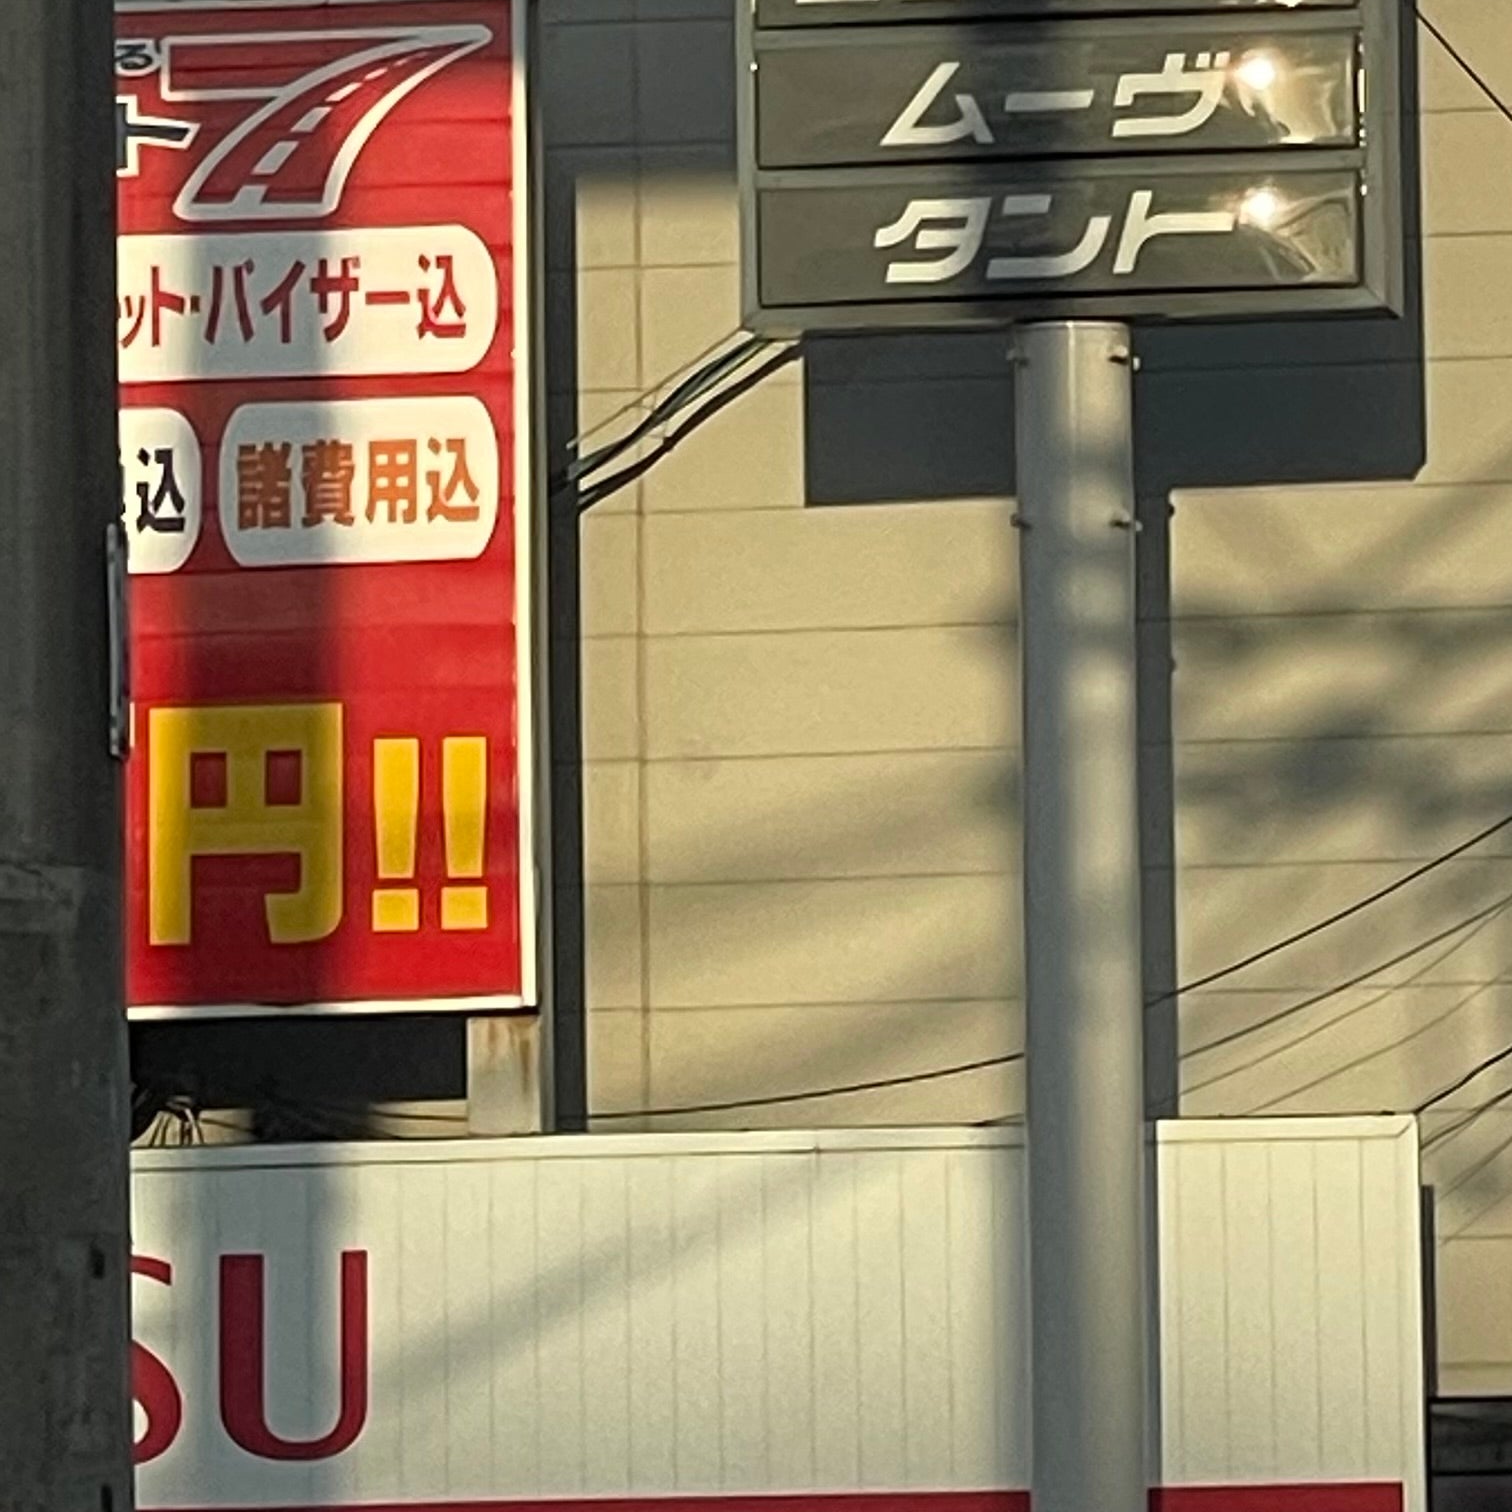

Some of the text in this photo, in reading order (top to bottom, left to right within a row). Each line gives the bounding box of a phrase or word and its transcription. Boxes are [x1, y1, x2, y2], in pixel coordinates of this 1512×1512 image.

[880, 51, 1231, 146] ムーヴ
[874, 190, 1237, 284] タント
[237, 437, 480, 532] 諸費用込
